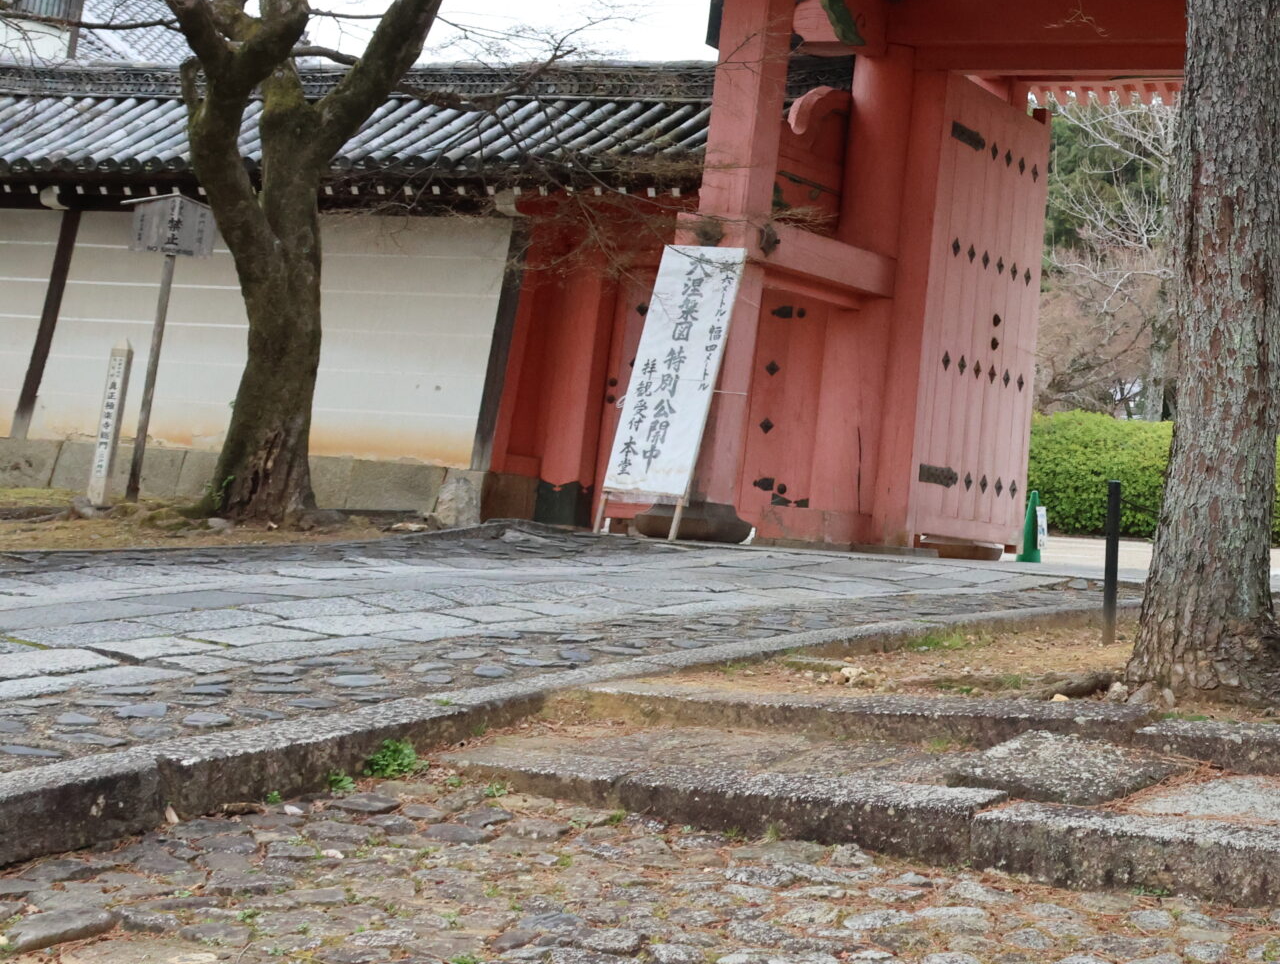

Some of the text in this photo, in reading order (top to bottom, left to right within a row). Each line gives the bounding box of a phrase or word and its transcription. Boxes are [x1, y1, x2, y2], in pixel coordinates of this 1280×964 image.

[164, 217, 183, 246] 禁止
[698, 261, 736, 391] 六メートル・幅四メートル
